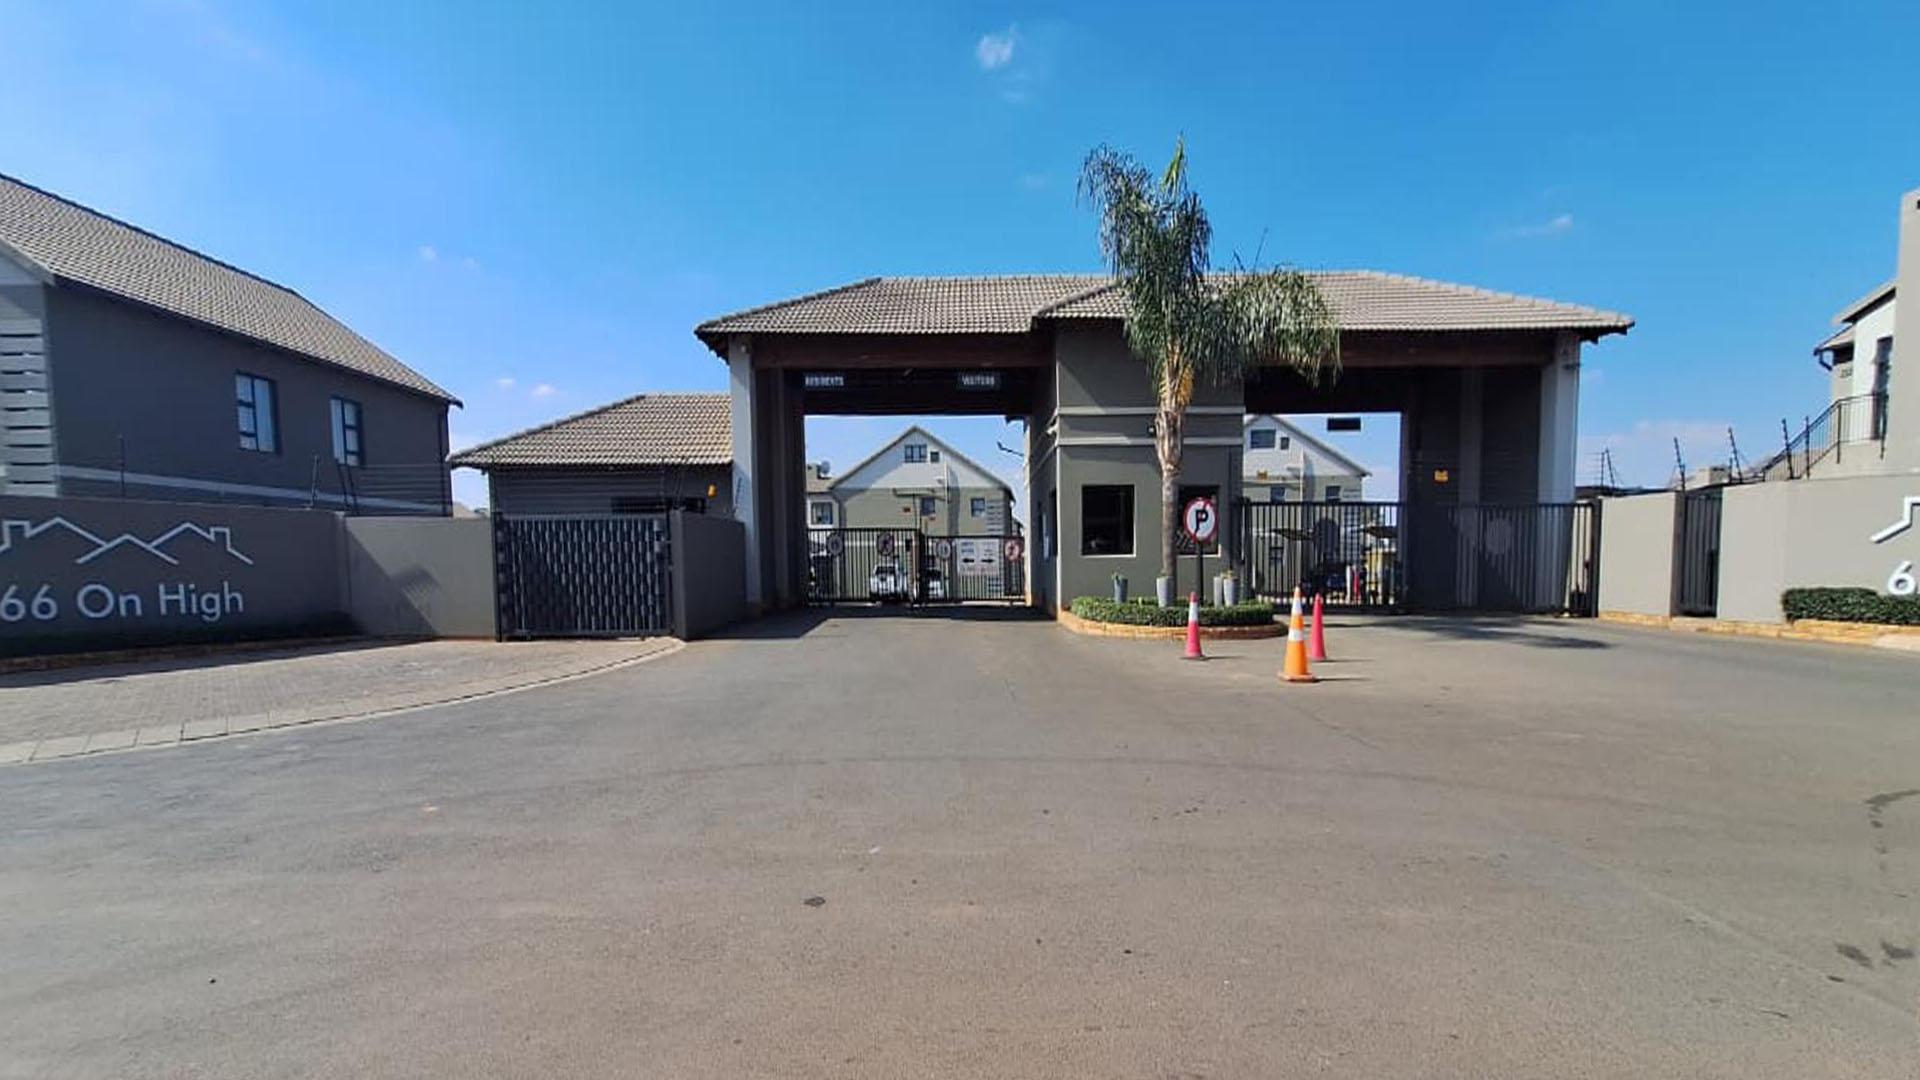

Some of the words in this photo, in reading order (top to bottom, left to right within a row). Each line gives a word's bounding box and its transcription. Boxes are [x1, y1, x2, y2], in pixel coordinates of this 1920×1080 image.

[1195, 509, 1209, 531] P
[1888, 561, 1916, 595] 6
[0, 584, 58, 621] 66
[77, 583, 142, 618] On
[158, 581, 244, 621] High
